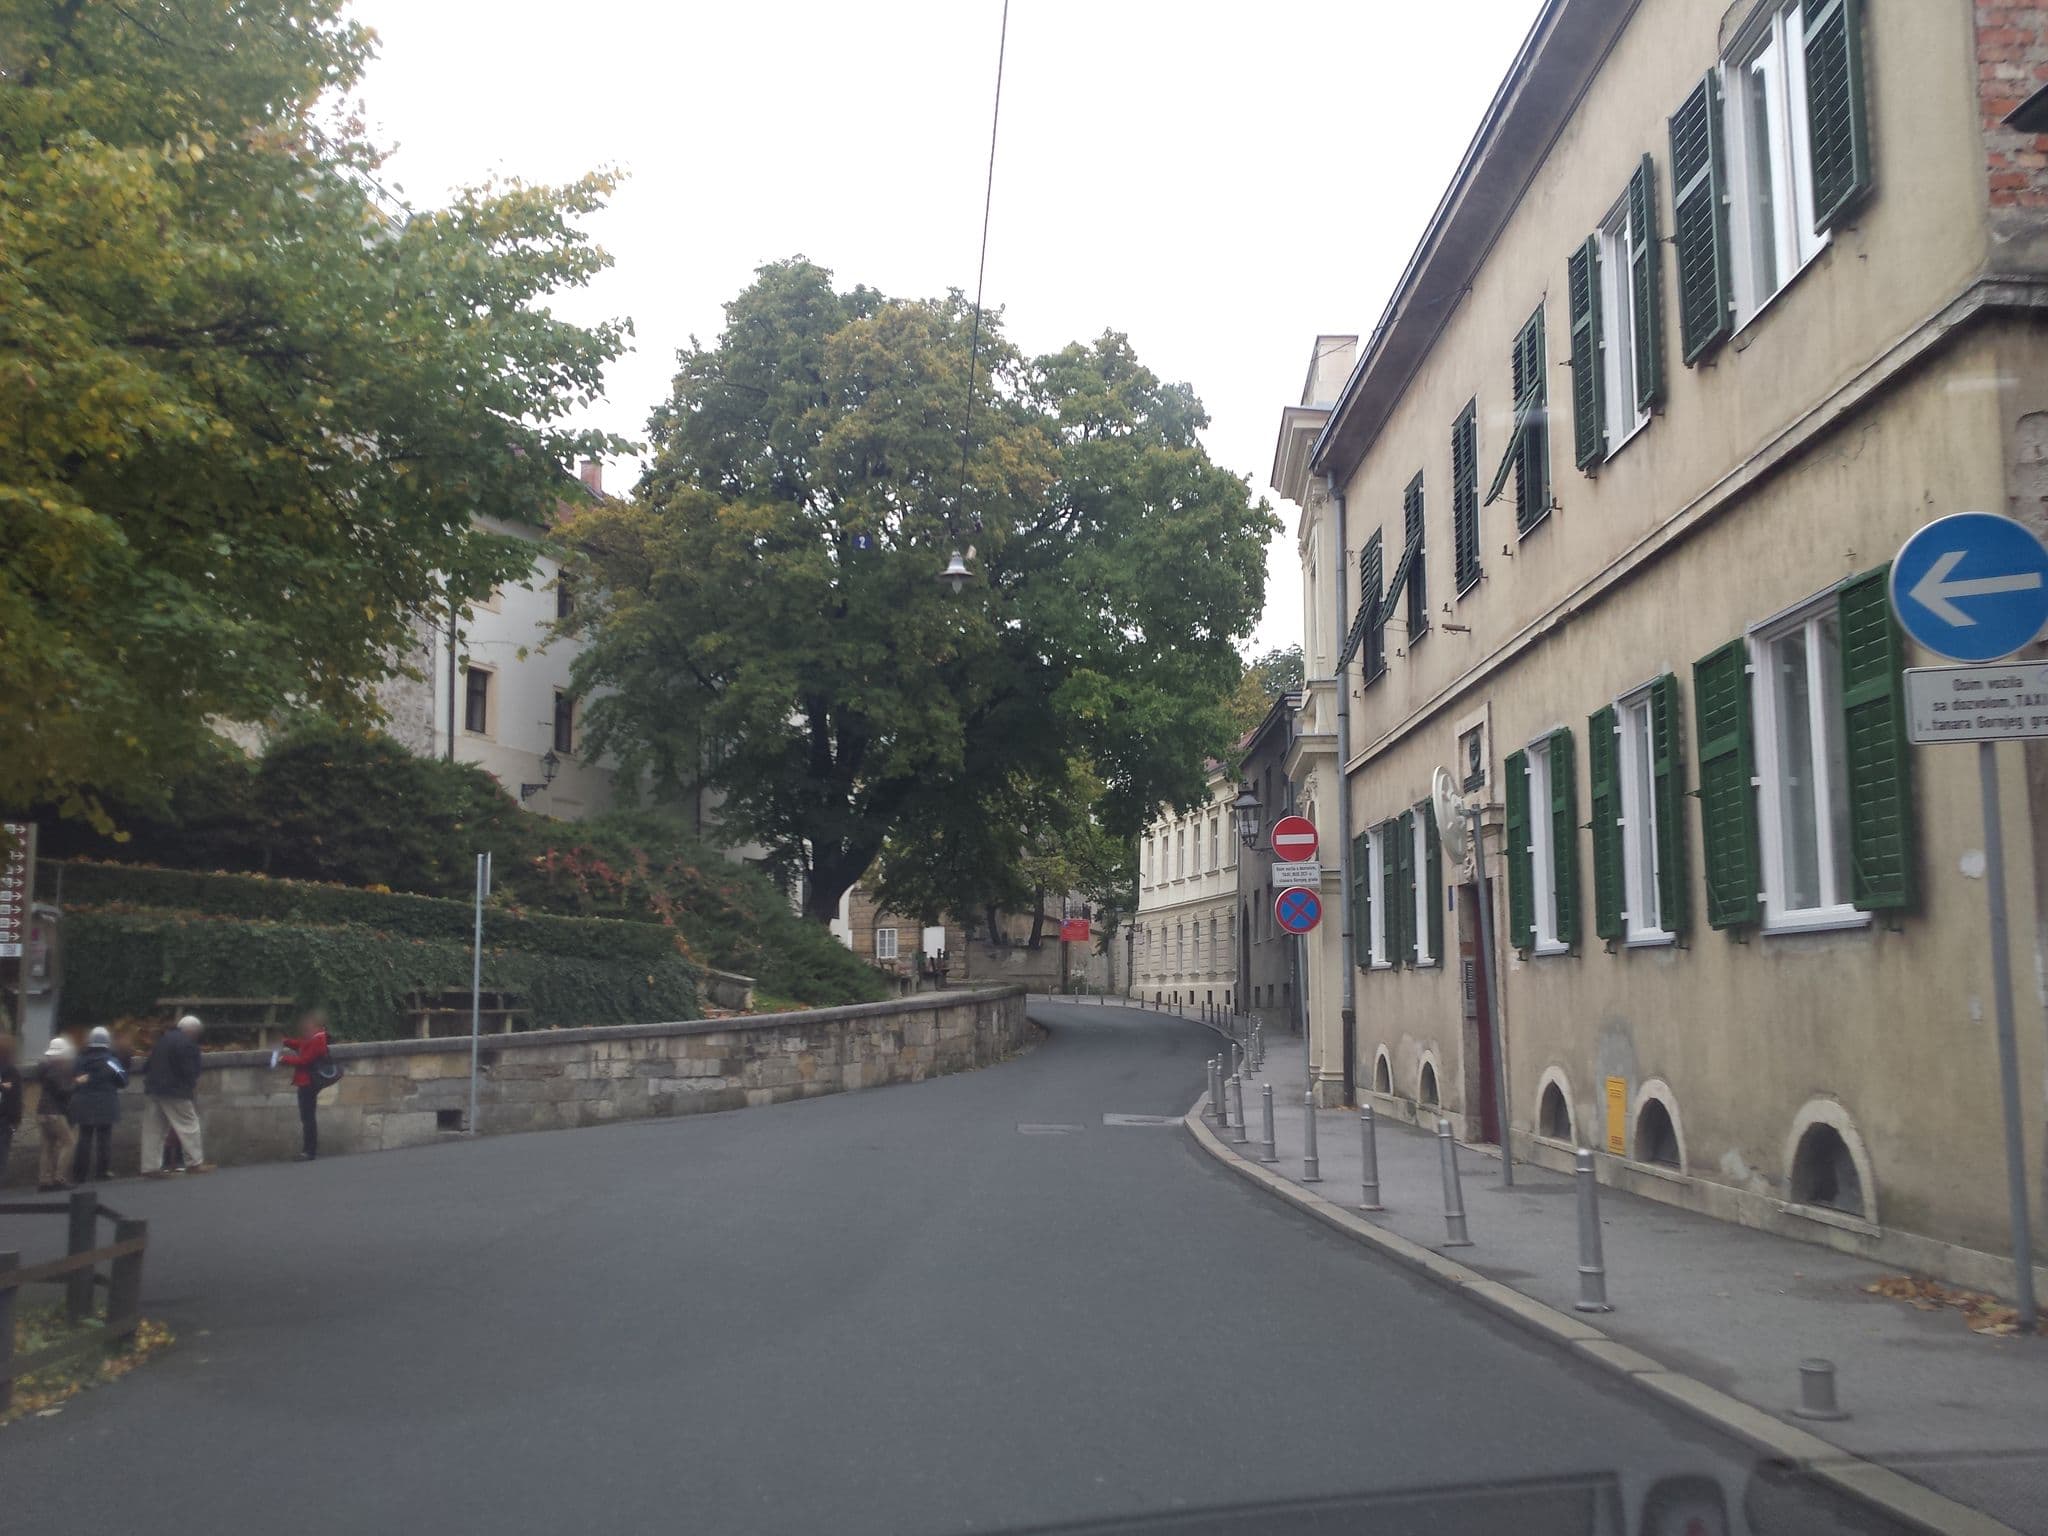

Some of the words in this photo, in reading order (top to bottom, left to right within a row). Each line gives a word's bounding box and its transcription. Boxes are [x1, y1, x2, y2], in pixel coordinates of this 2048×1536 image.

[858, 536, 866, 549] 2
[1988, 676, 2024, 689] vozila
[1925, 719, 1972, 730] tanara
